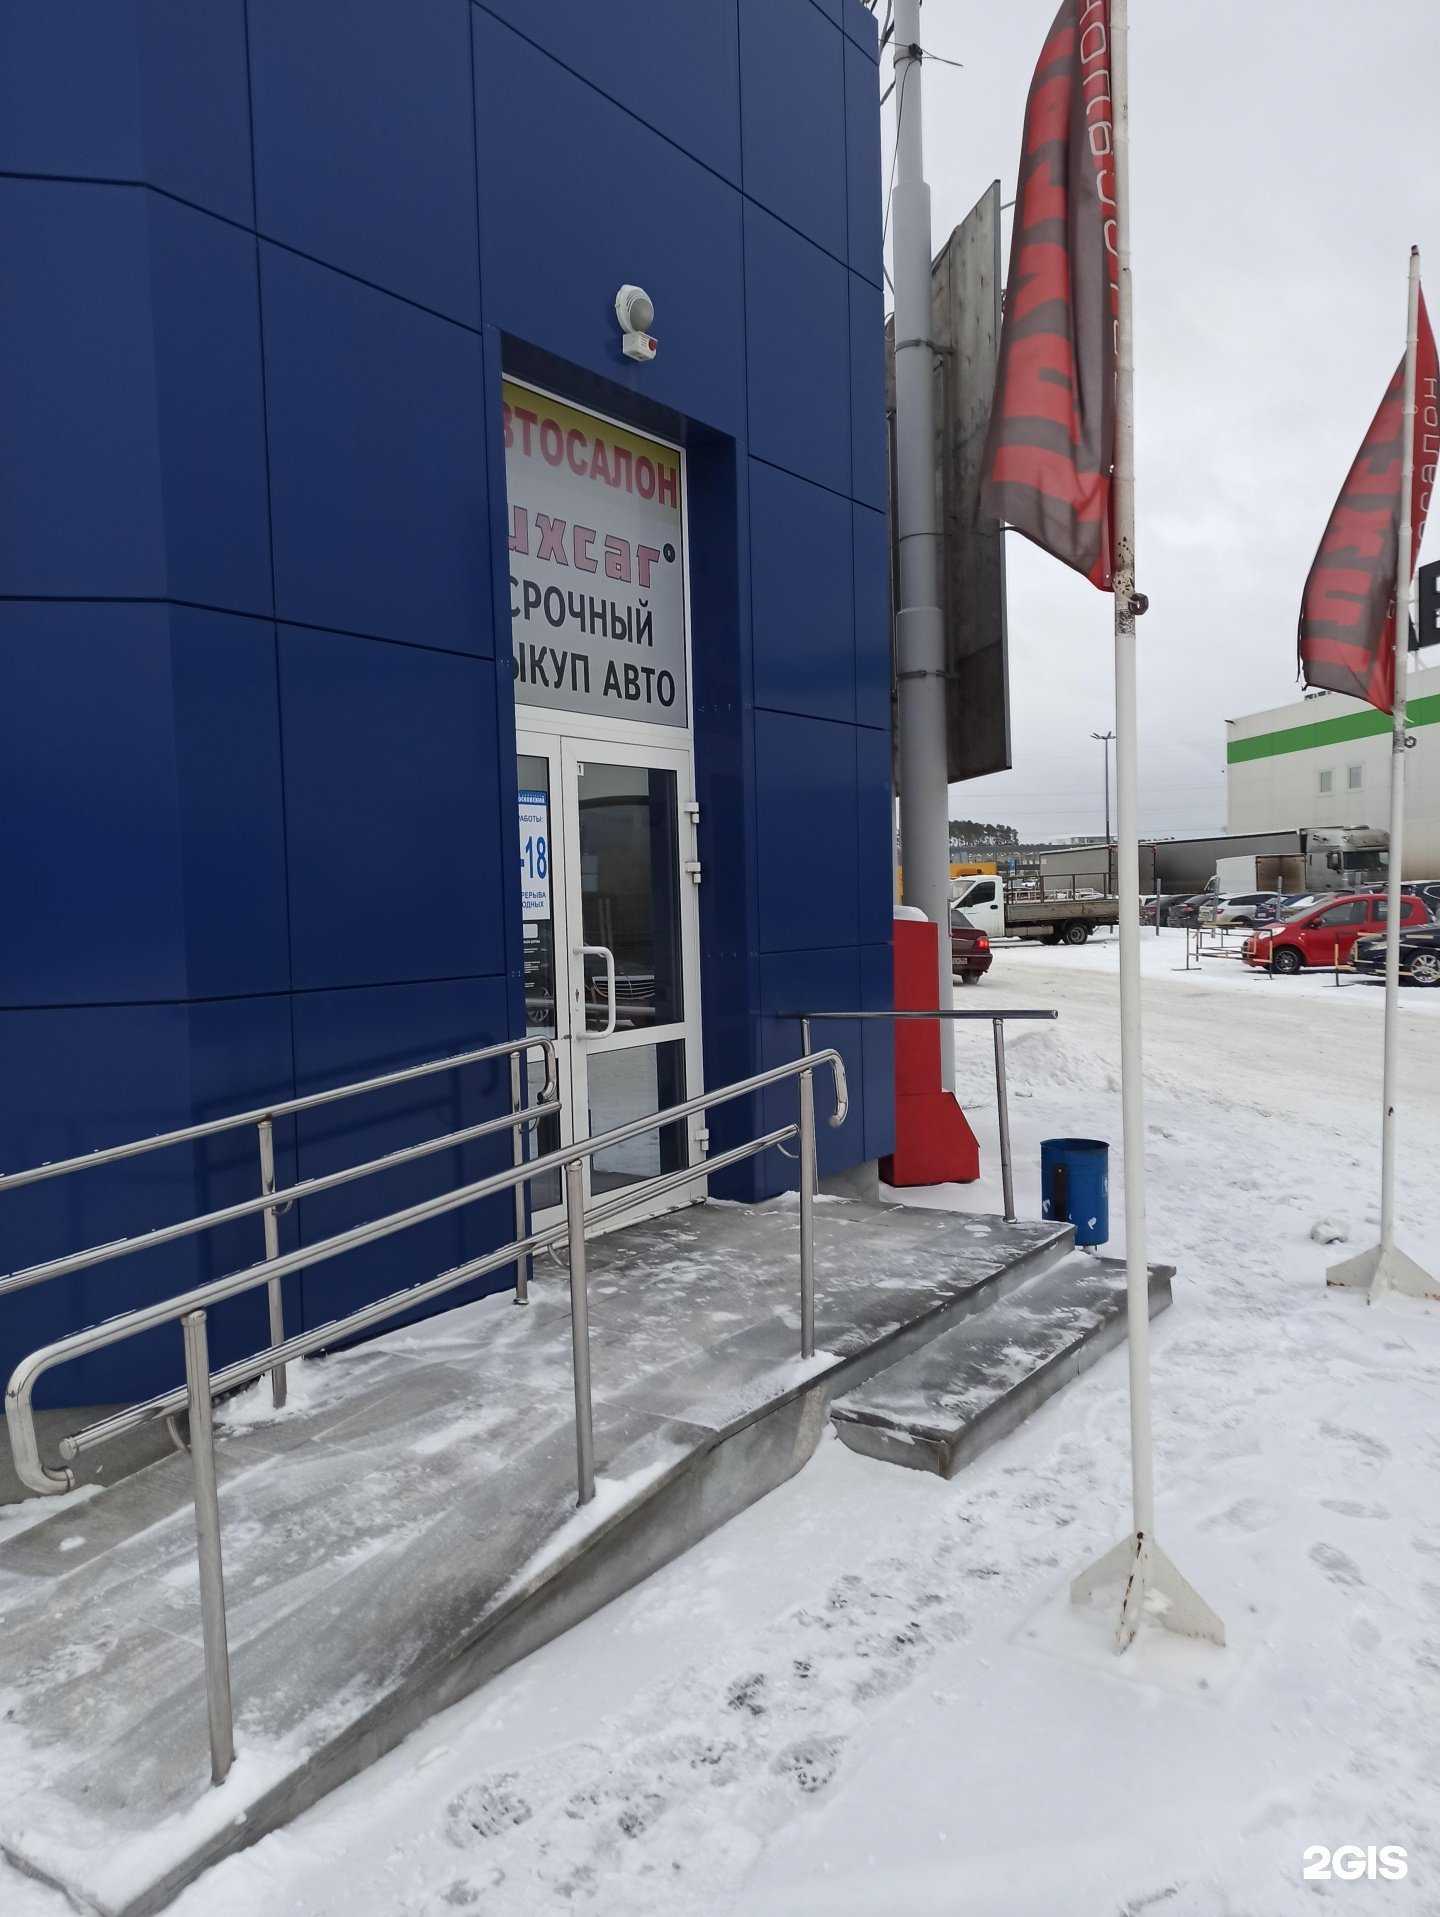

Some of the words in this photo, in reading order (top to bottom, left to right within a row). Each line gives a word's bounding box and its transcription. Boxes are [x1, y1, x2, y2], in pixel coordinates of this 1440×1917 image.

[502, 401, 677, 508] ВТОСАЛОН
[510, 575, 653, 647] СРОЧНЫЙ
[603, 660, 675, 707] АВТО
